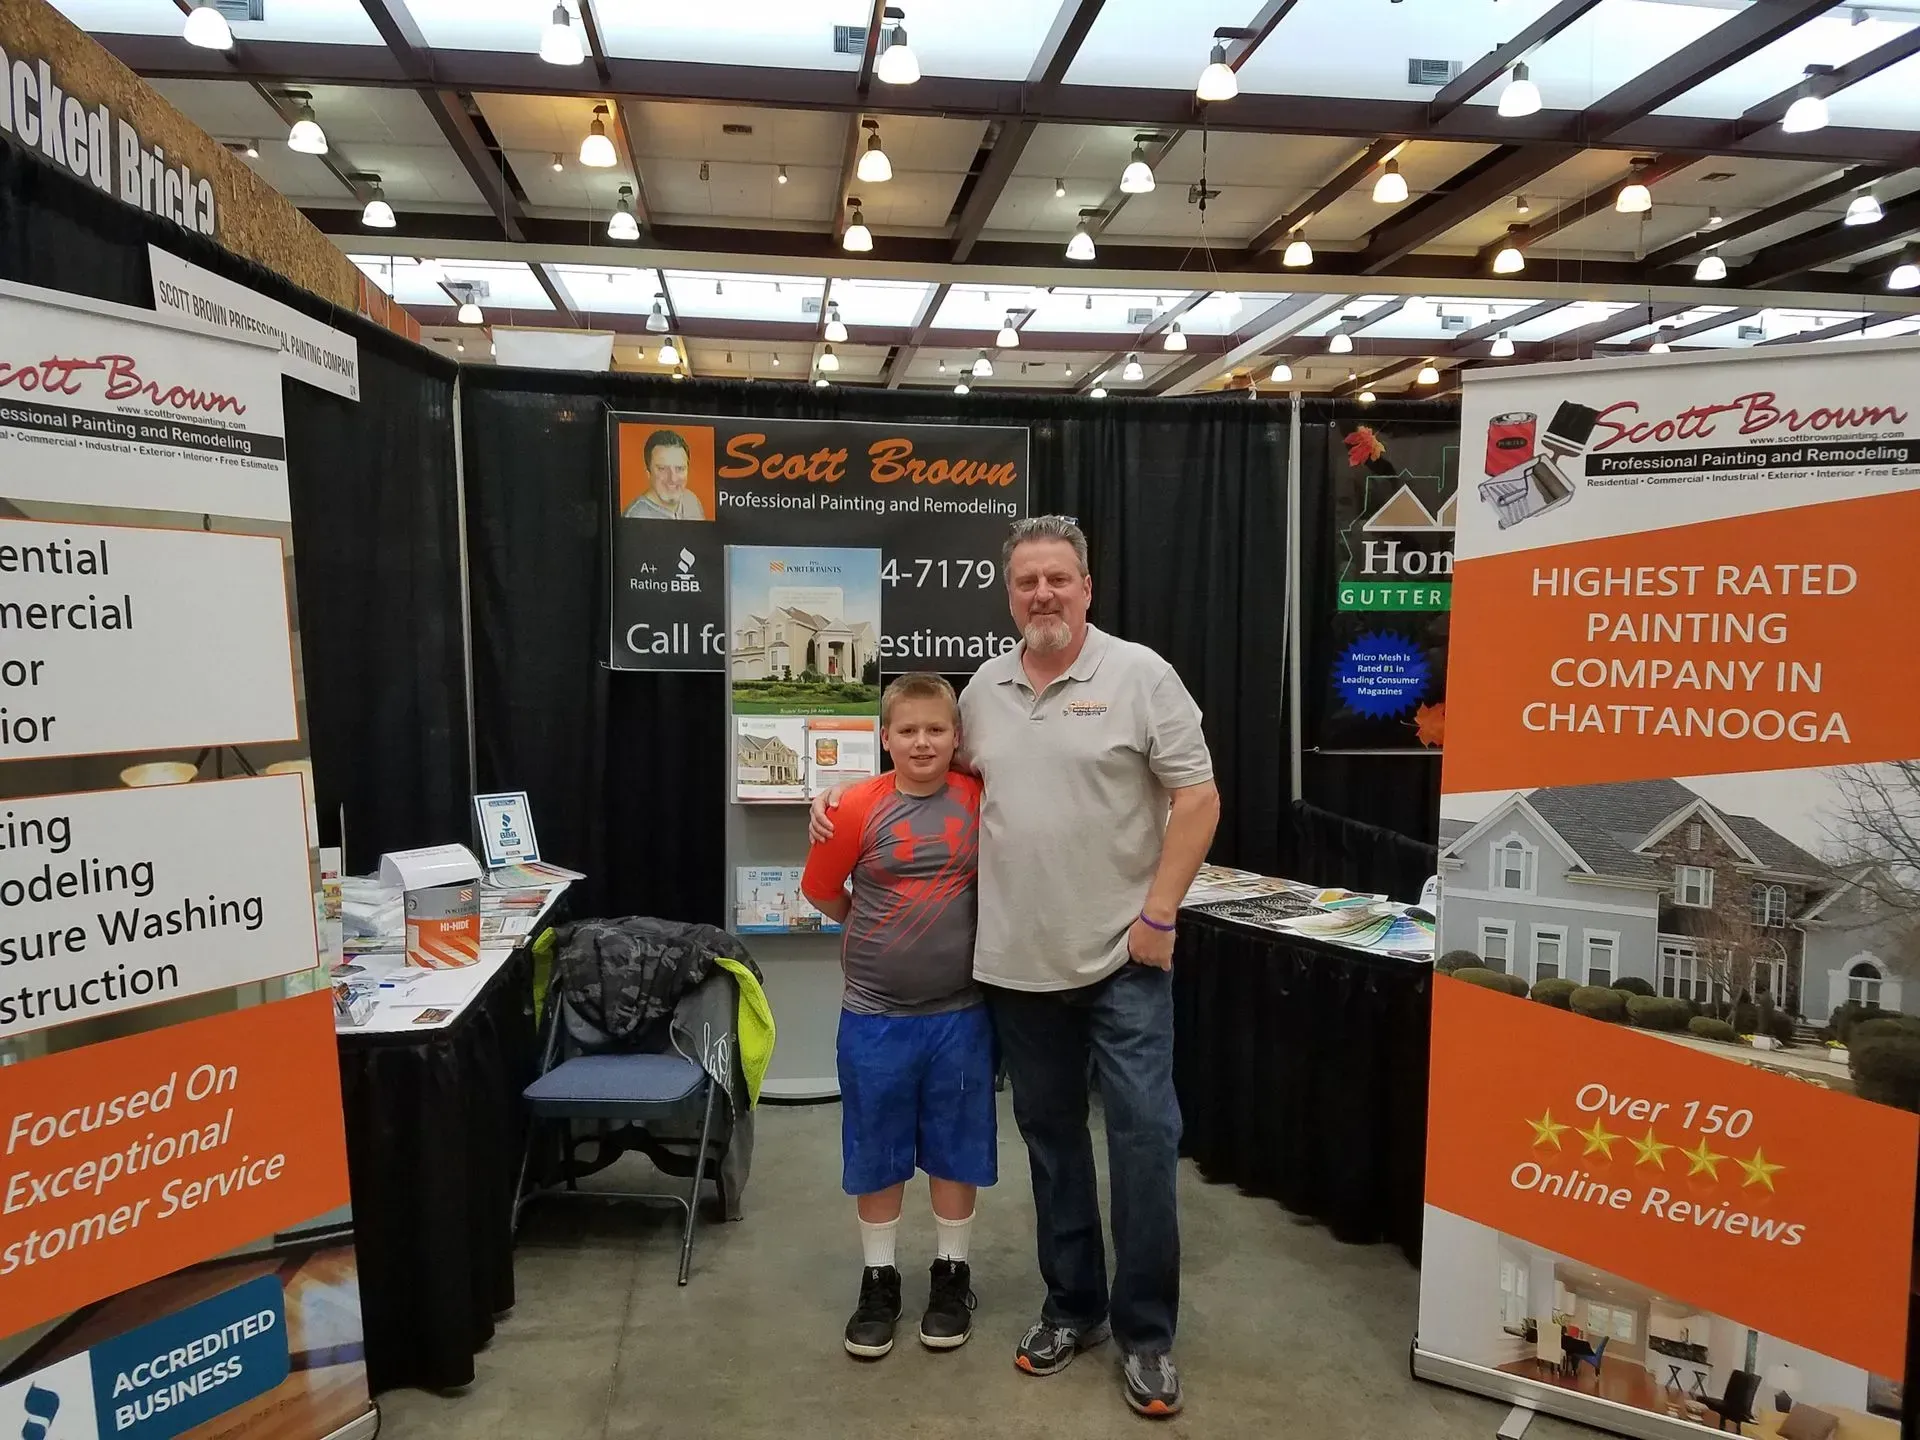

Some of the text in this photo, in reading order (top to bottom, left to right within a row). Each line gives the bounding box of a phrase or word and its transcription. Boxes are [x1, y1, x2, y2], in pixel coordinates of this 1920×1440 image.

[159, 280, 190, 314] SCOTT
[192, 294, 228, 327] BROWN
[291, 335, 322, 367] PAINTING
[322, 349, 355, 380] COMPANY
[96, 354, 247, 416] Brown
[72, 414, 137, 438] Painting
[141, 426, 168, 439] and
[172, 427, 252, 453] Remodeling
[117, 405, 247, 430] www.scottbrownpainting.com
[1592, 391, 1909, 452] Scott Brown
[17, 432, 77, 447] Commercial
[86, 440, 131, 453] Industrial
[139, 445, 175, 458] Exterior
[183, 451, 213, 463] Interior
[220, 456, 239, 466] Free
[241, 458, 279, 472] Estimates
[1749, 431, 1905, 444] www.scottbrownpainting.com
[718, 433, 1018, 487] Scott Brown
[1601, 446, 1909, 471] Professional Painting and Remodeling
[1587, 478, 1639, 487] Residential
[1646, 475, 1704, 485] Commercial
[1712, 472, 1759, 482] Industrial
[1767, 470, 1807, 480] Exterior
[1816, 469, 1855, 478] Interior
[1864, 468, 1889, 477] Free
[719, 491, 1017, 518] Professional Painting and Remodeling
[0, 538, 109, 575] ential
[640, 562, 658, 574] A+
[881, 558, 996, 589] 4-7179
[630, 578, 668, 593] Rating
[1340, 588, 1442, 605] GUTTER
[1531, 564, 1858, 597] HIGHEST RATED
[626, 622, 689, 655] Call
[880, 628, 1017, 658] estimate
[1587, 612, 1788, 645] PAINTING
[2, 659, 45, 687] or
[1352, 653, 1376, 662] Micro
[1378, 653, 1401, 662] Mesh
[1357, 664, 1382, 673] Rated
[1550, 657, 1822, 693] COMPANY IN
[1342, 675, 1420, 685] Leading Consumer
[1357, 687, 1403, 696] Magazines
[1, 707, 56, 744] ior
[1521, 702, 1852, 744] CHATTANOOGA
[0, 858, 155, 906] odeling
[0, 894, 264, 966] sure Washing
[440, 919, 470, 932] HI-HIDE
[0, 963, 179, 1025] struction
[7, 1063, 239, 1154] Focused On
[1575, 1082, 1754, 1139] Over 150
[3, 1108, 235, 1216] Exceptional
[0, 1153, 286, 1275] stomer Service
[1510, 1161, 1806, 1246] Online Reviews
[112, 1308, 276, 1399] ACCREDITED
[116, 1355, 243, 1432] BUSINESS
